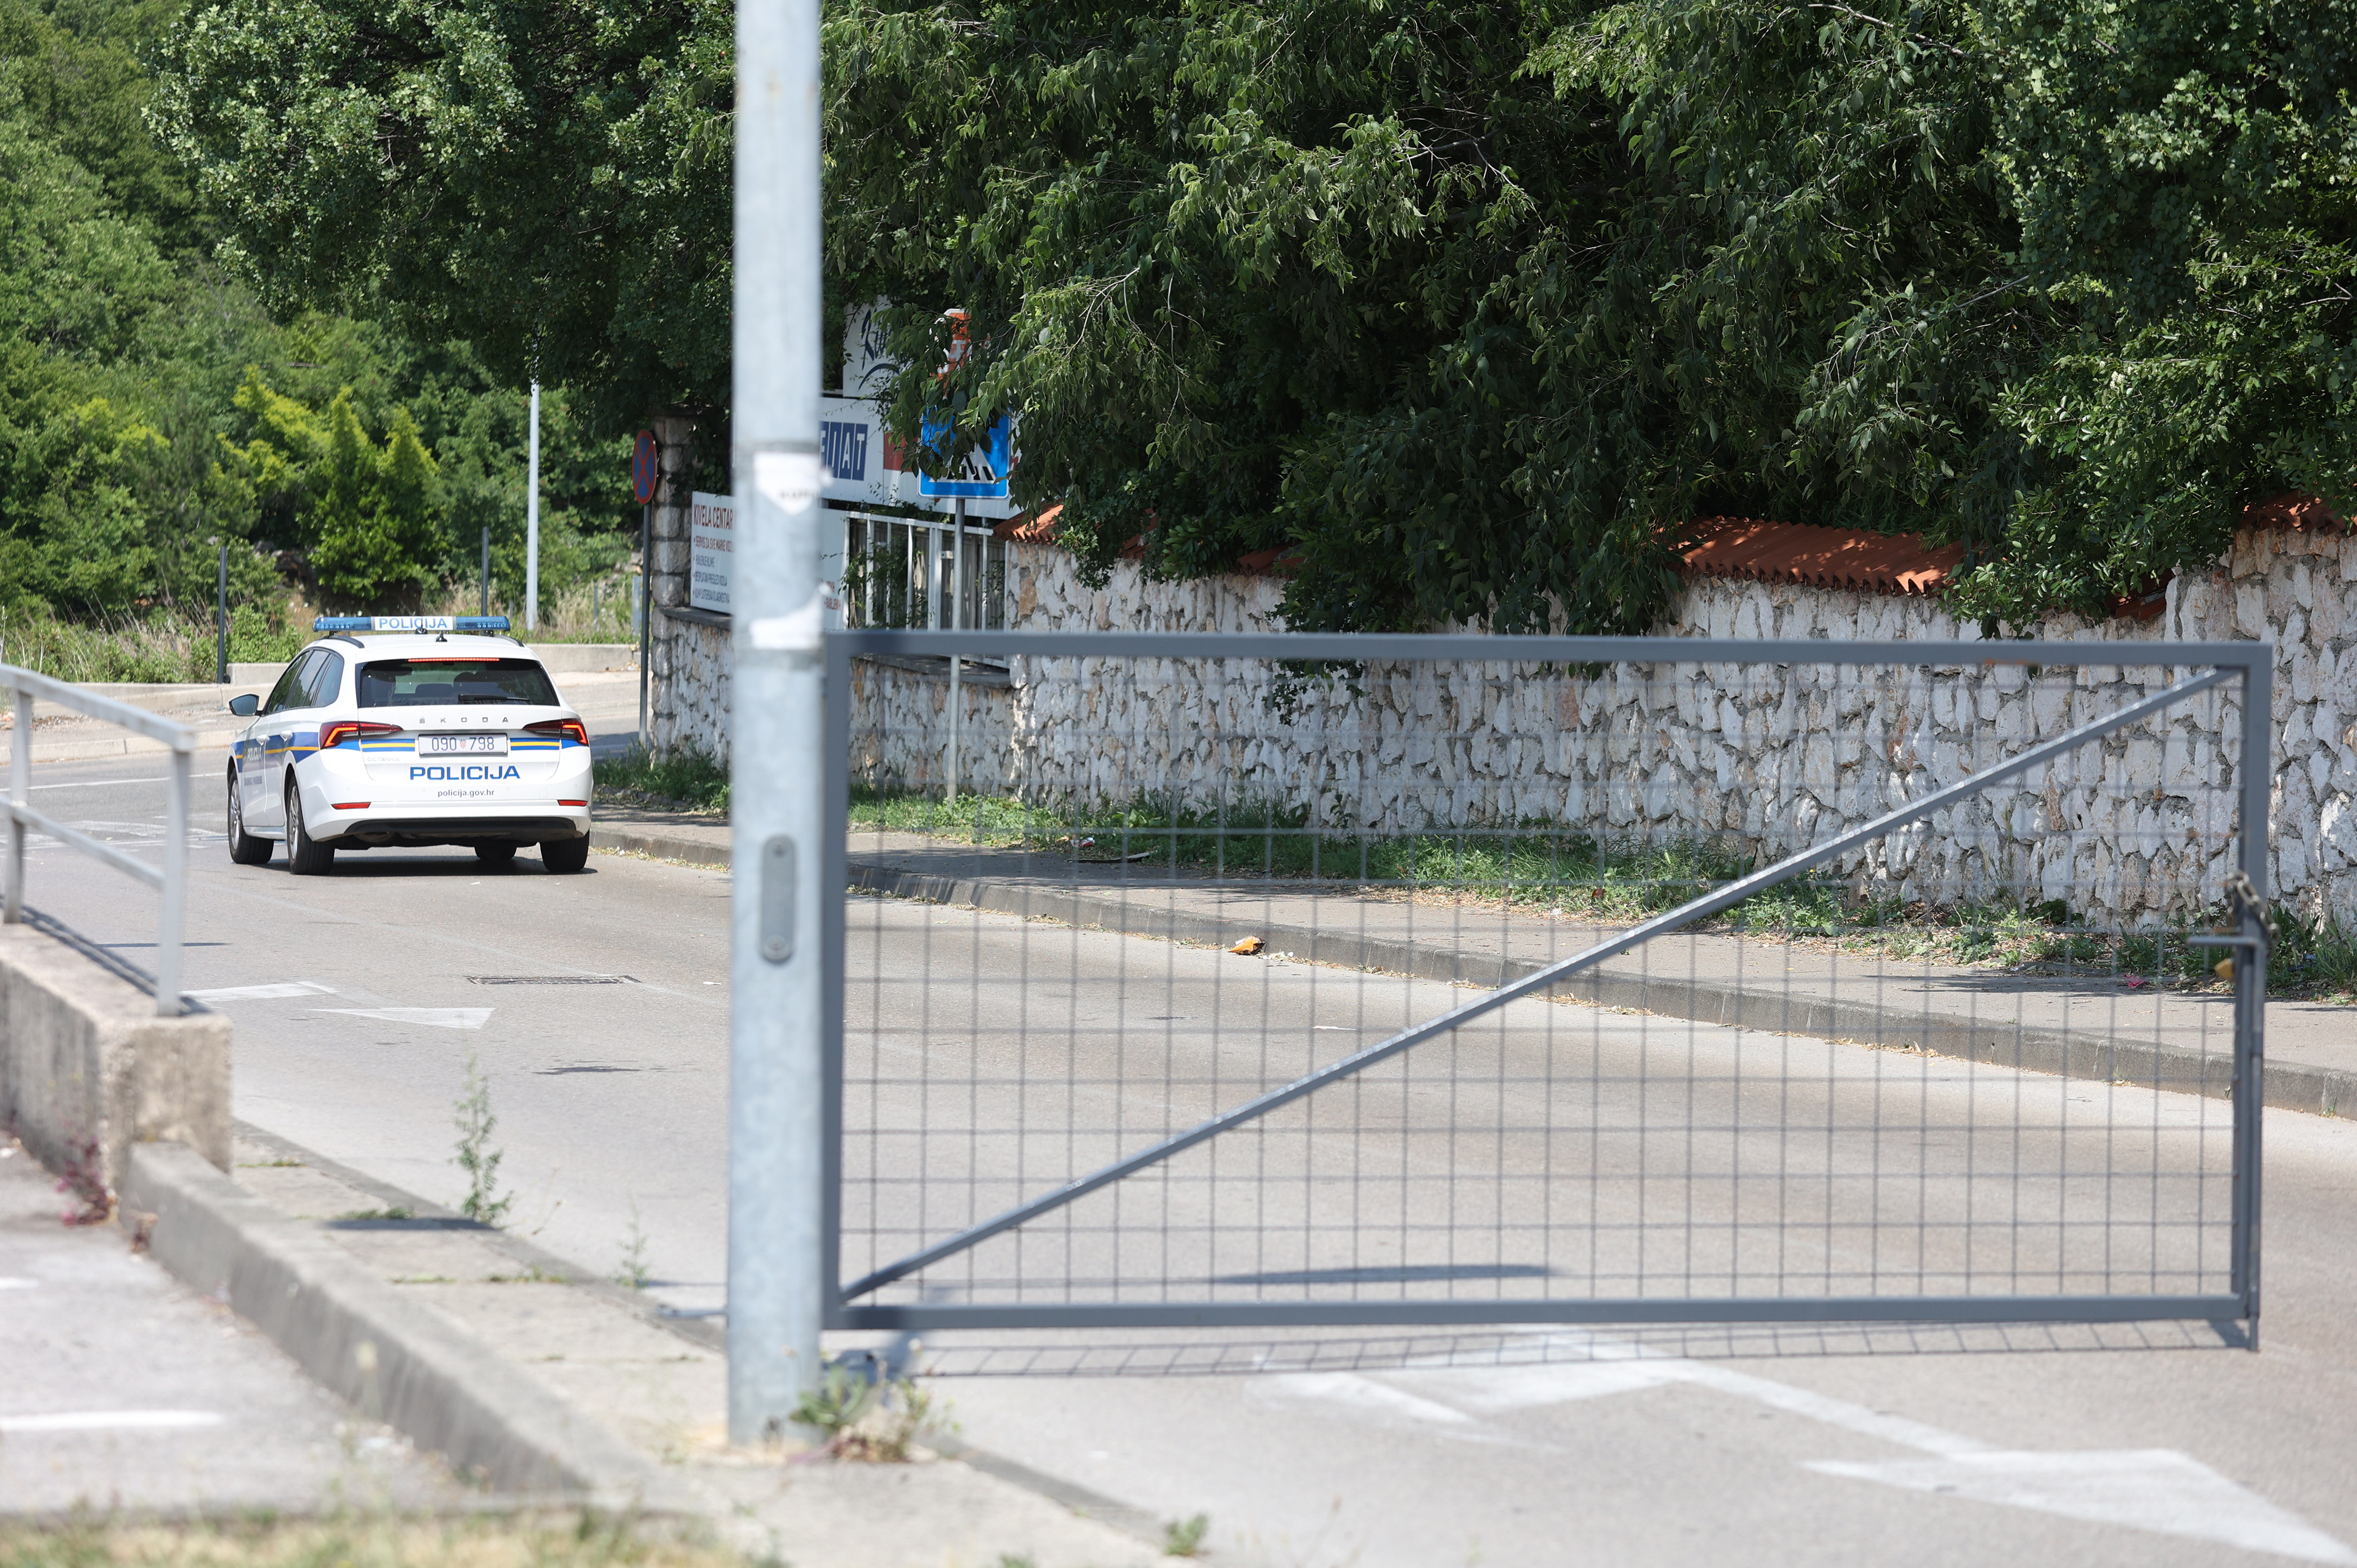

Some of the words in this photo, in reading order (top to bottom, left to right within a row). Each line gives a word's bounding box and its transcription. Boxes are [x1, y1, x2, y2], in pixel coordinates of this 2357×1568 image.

[819, 430, 866, 471] FIAT
[694, 504, 712, 527] KIVELA
[713, 506, 734, 530] CENTAR
[379, 618, 448, 629] POLICIJA
[431, 737, 457, 751] 090
[469, 736, 494, 751] 798
[410, 765, 520, 780] POLICIJA
[437, 788, 495, 798] policija.gov.hr
